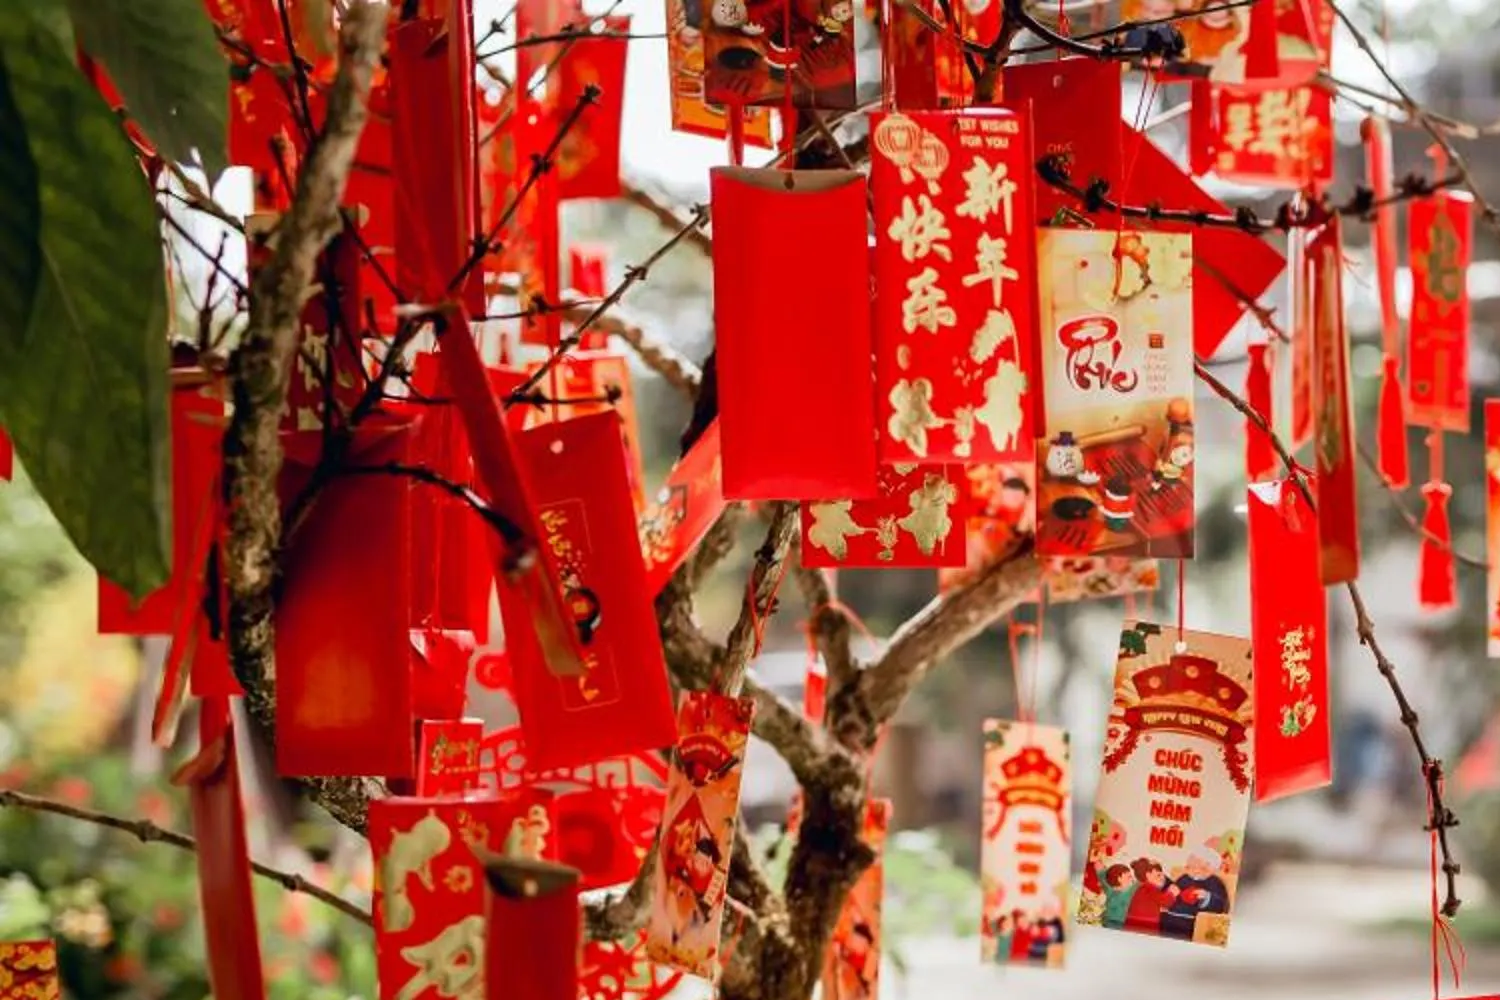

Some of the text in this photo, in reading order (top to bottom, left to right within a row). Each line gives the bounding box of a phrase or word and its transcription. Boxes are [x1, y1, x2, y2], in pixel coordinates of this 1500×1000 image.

[954, 155, 1019, 307] 新年
[887, 193, 957, 334] 快乐
[1154, 748, 1203, 772] CHÚC
[1148, 771, 1201, 798] MỪNG
[1150, 799, 1191, 822] NĂM
[1150, 824, 1184, 848] MỚI
